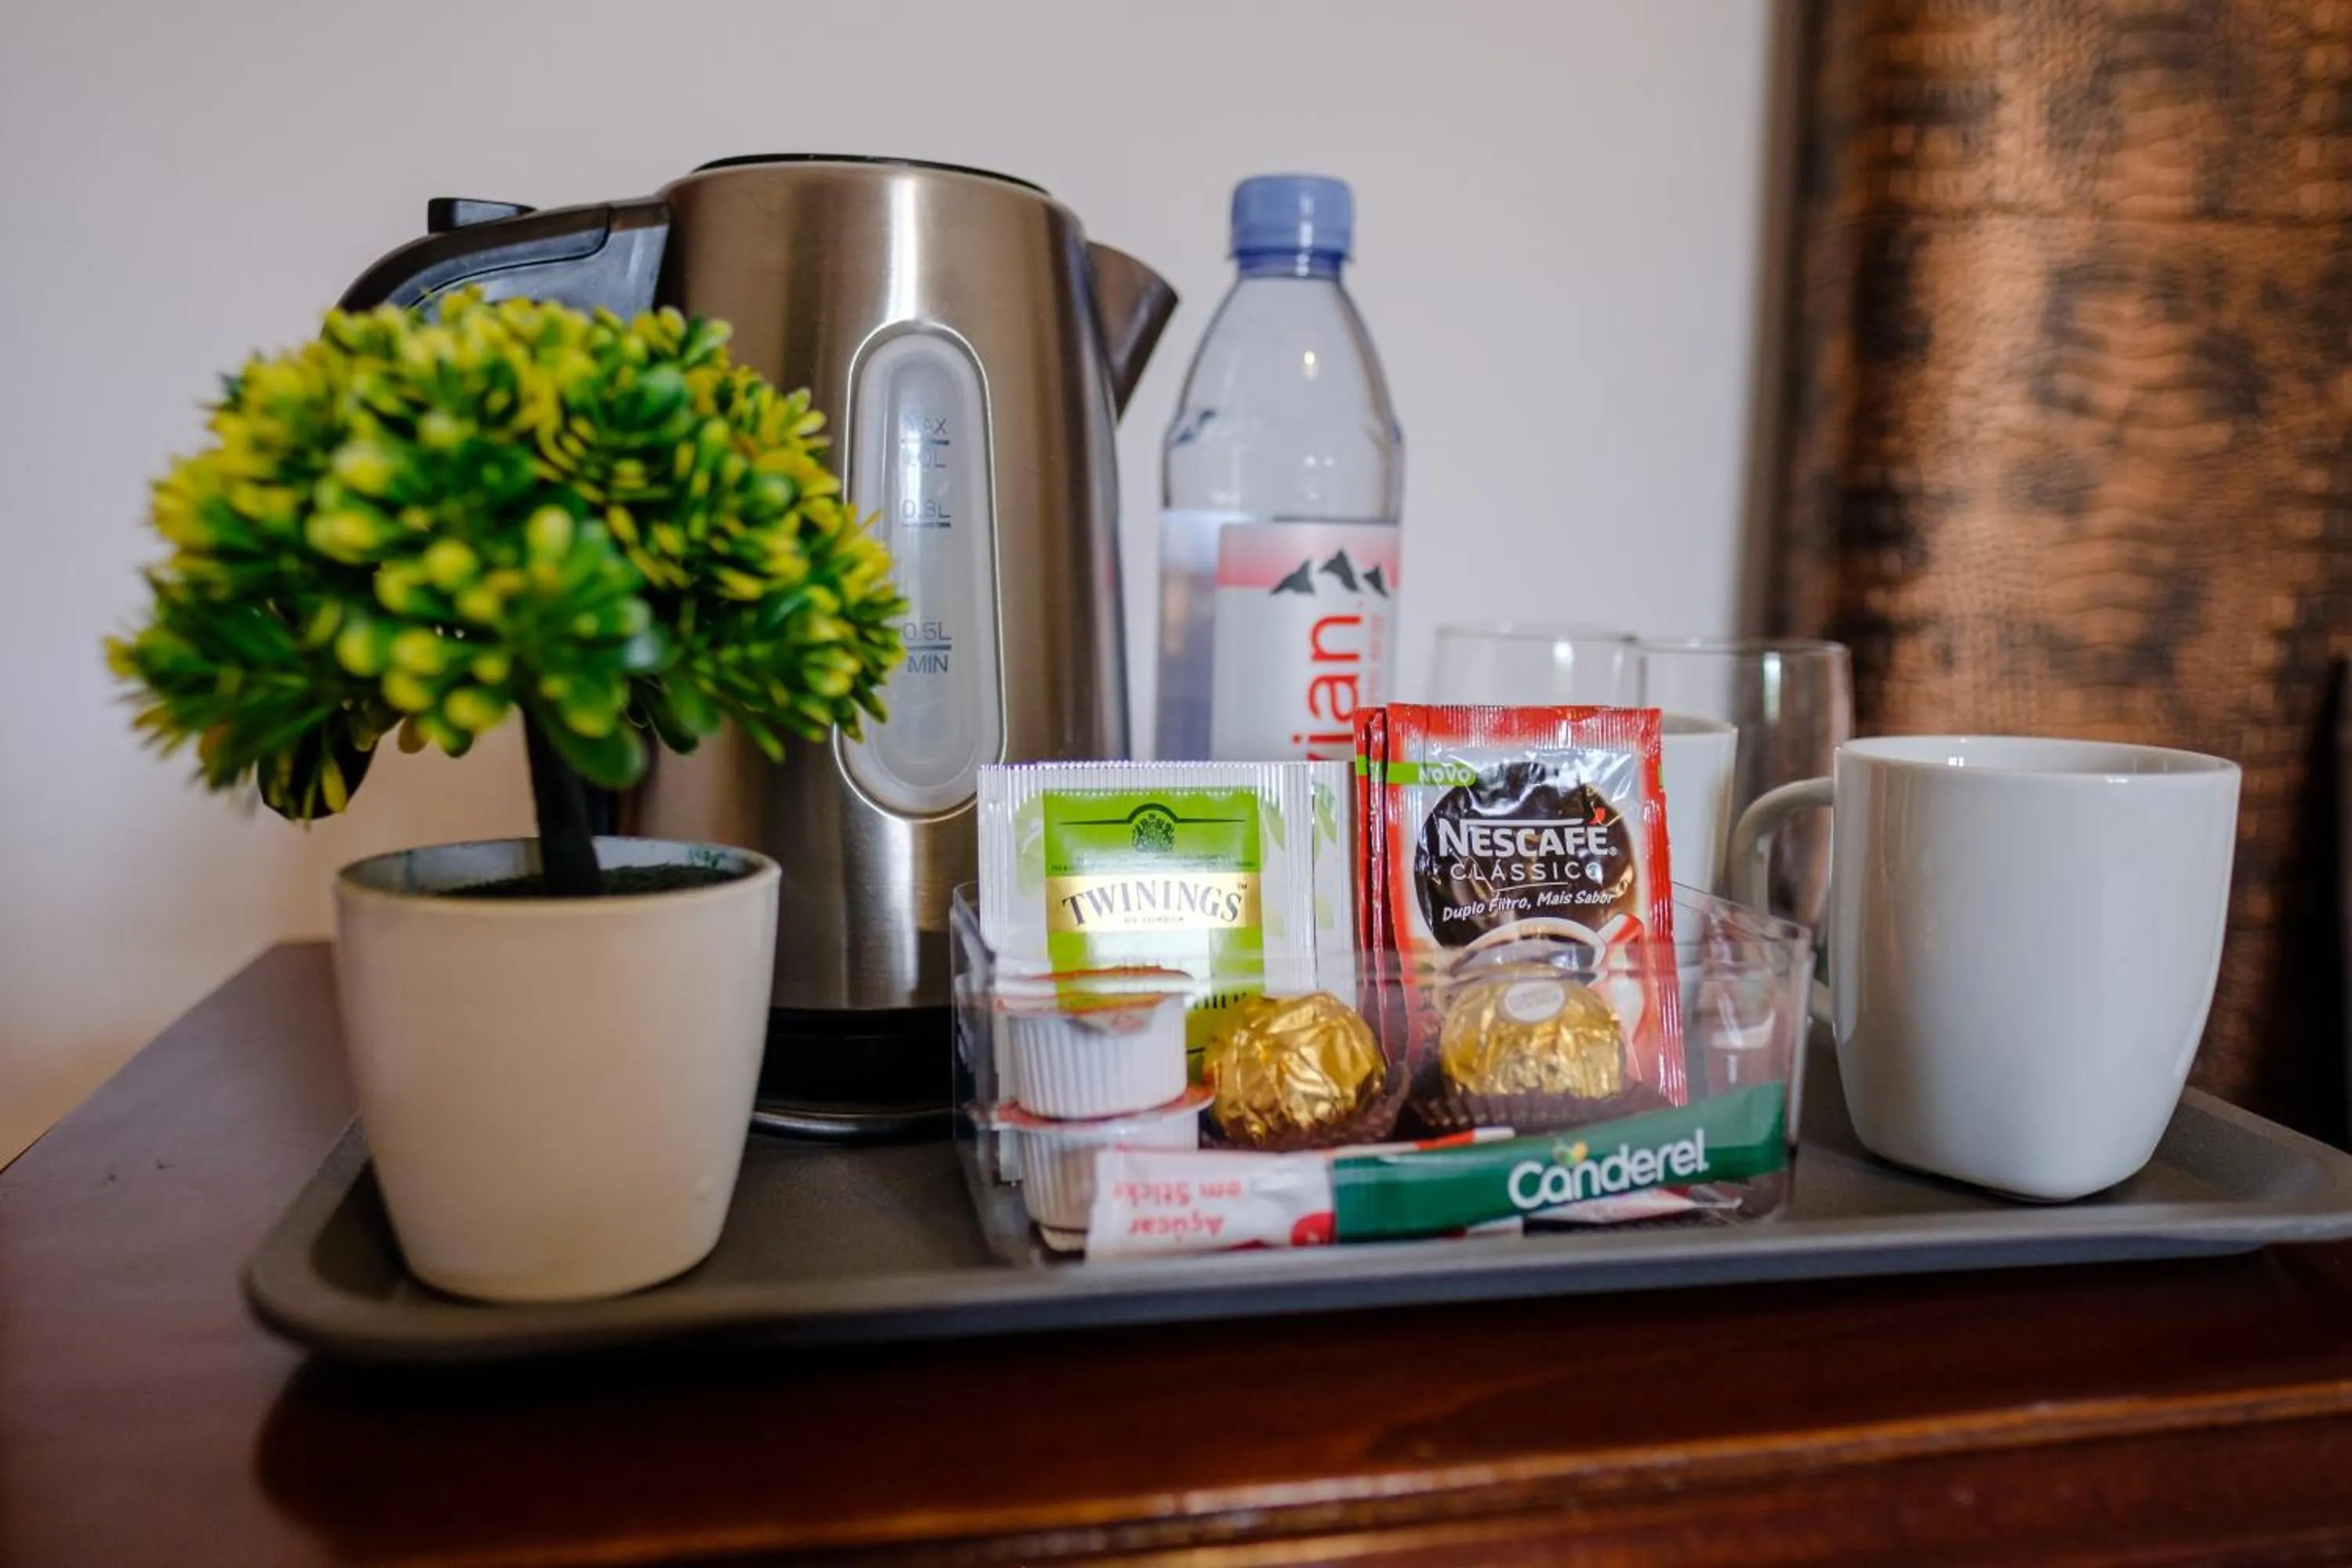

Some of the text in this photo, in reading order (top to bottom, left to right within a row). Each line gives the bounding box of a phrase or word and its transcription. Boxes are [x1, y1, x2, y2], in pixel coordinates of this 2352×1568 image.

[903, 622, 953, 641] 0.5L
[907, 654, 949, 673] MIN
[1292, 615, 1362, 760] ian
[1450, 860, 1602, 882] CLÁSSICO
[1062, 880, 1242, 927] TWININGS
[1443, 890, 1617, 922] Duplo Filtro, Mais Sabor
[1508, 1127, 1706, 1209] Canderel
[1198, 1179, 1243, 1199] em
